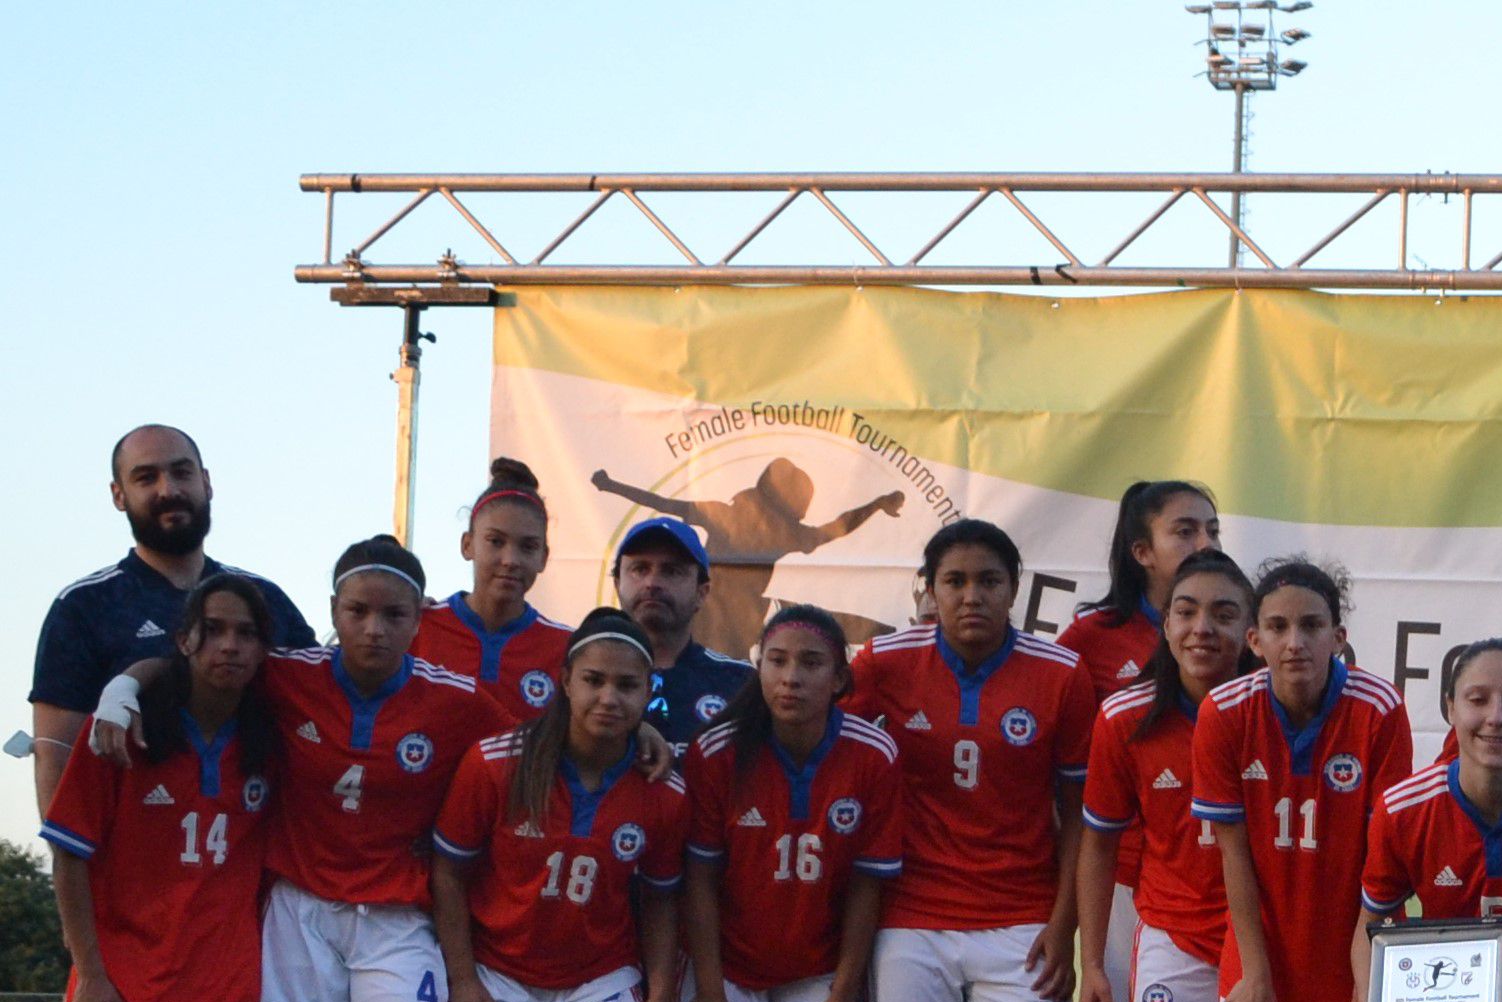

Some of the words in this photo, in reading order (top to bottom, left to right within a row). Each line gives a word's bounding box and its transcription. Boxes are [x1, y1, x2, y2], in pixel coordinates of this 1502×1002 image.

[665, 406, 745, 458] Female
[751, 400, 844, 434] Football
[849, 412, 962, 526] Tournament
[333, 764, 366, 814] 4
[952, 739, 980, 789] 9
[180, 811, 229, 865] 14
[1274, 796, 1319, 849] 11
[540, 851, 600, 904] 18
[773, 832, 823, 882] 16
